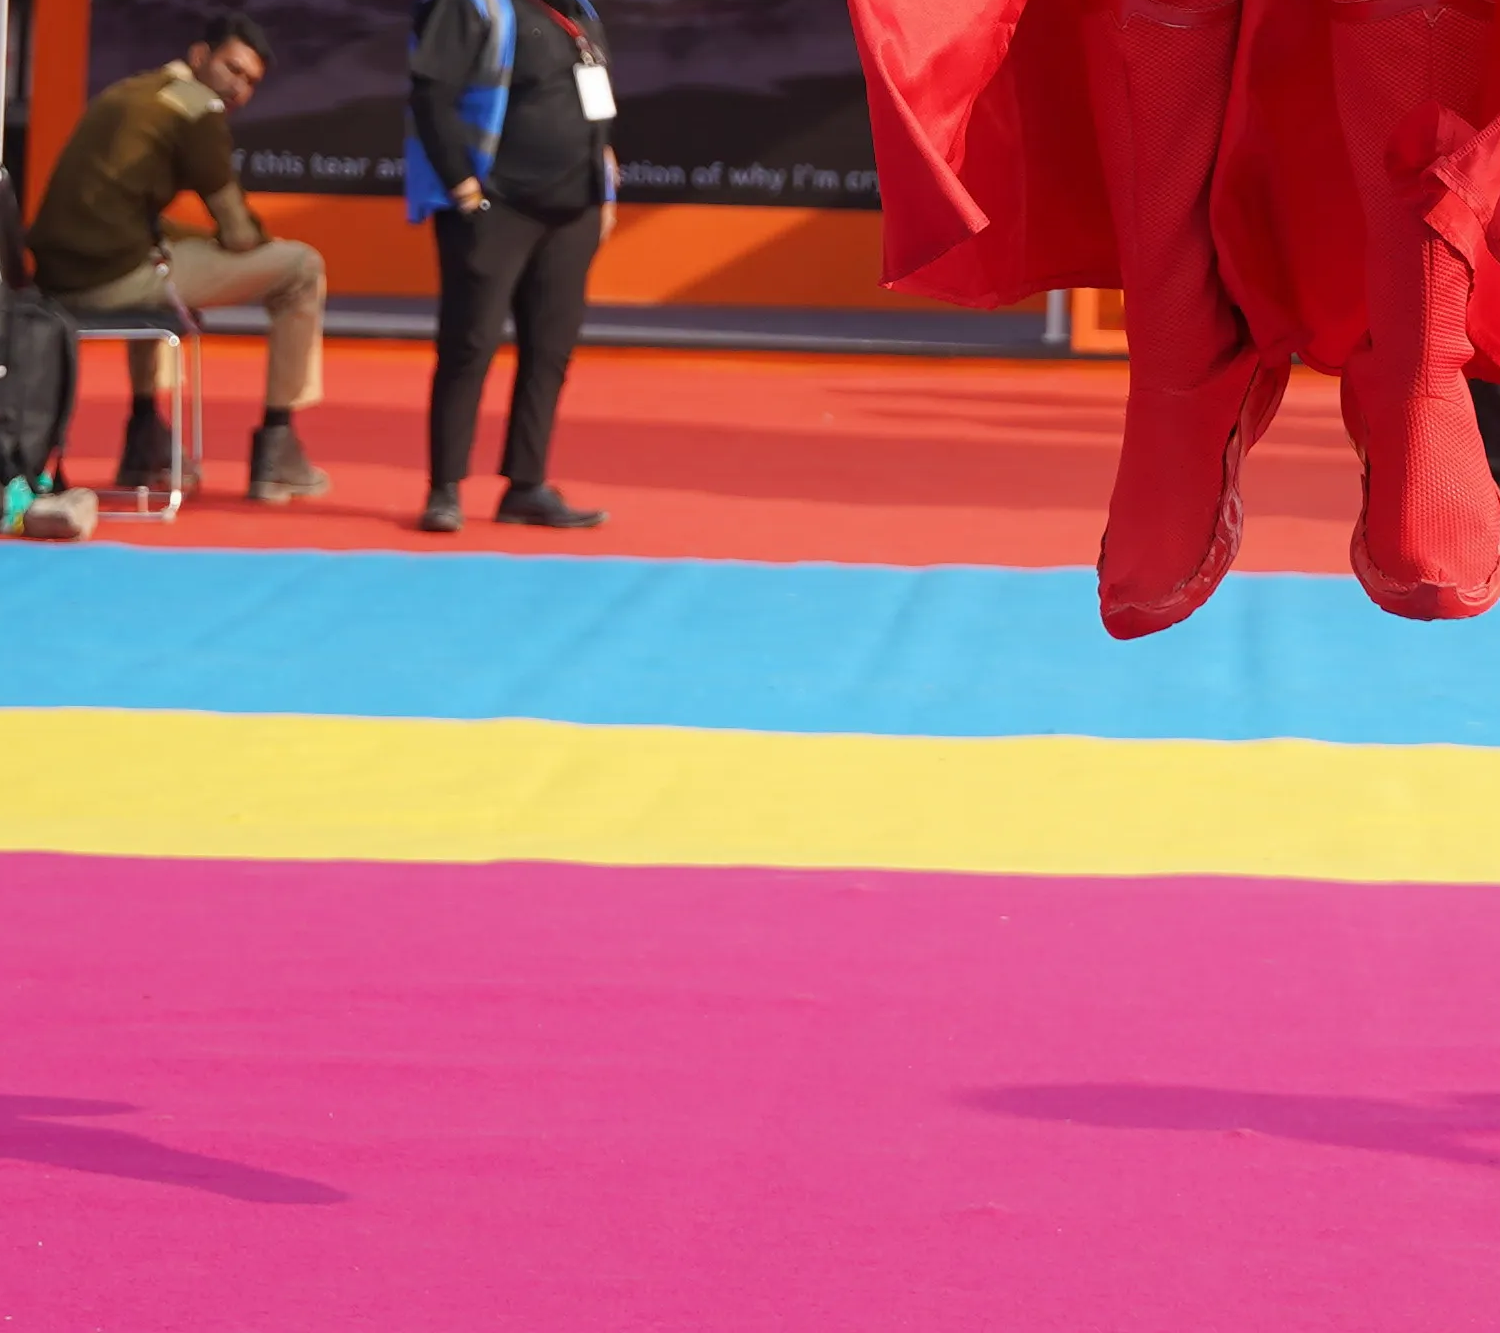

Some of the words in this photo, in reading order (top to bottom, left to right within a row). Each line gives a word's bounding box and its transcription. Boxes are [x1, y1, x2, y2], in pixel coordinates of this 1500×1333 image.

[252, 149, 305, 179] this
[690, 161, 724, 190] of
[728, 162, 787, 197] why
